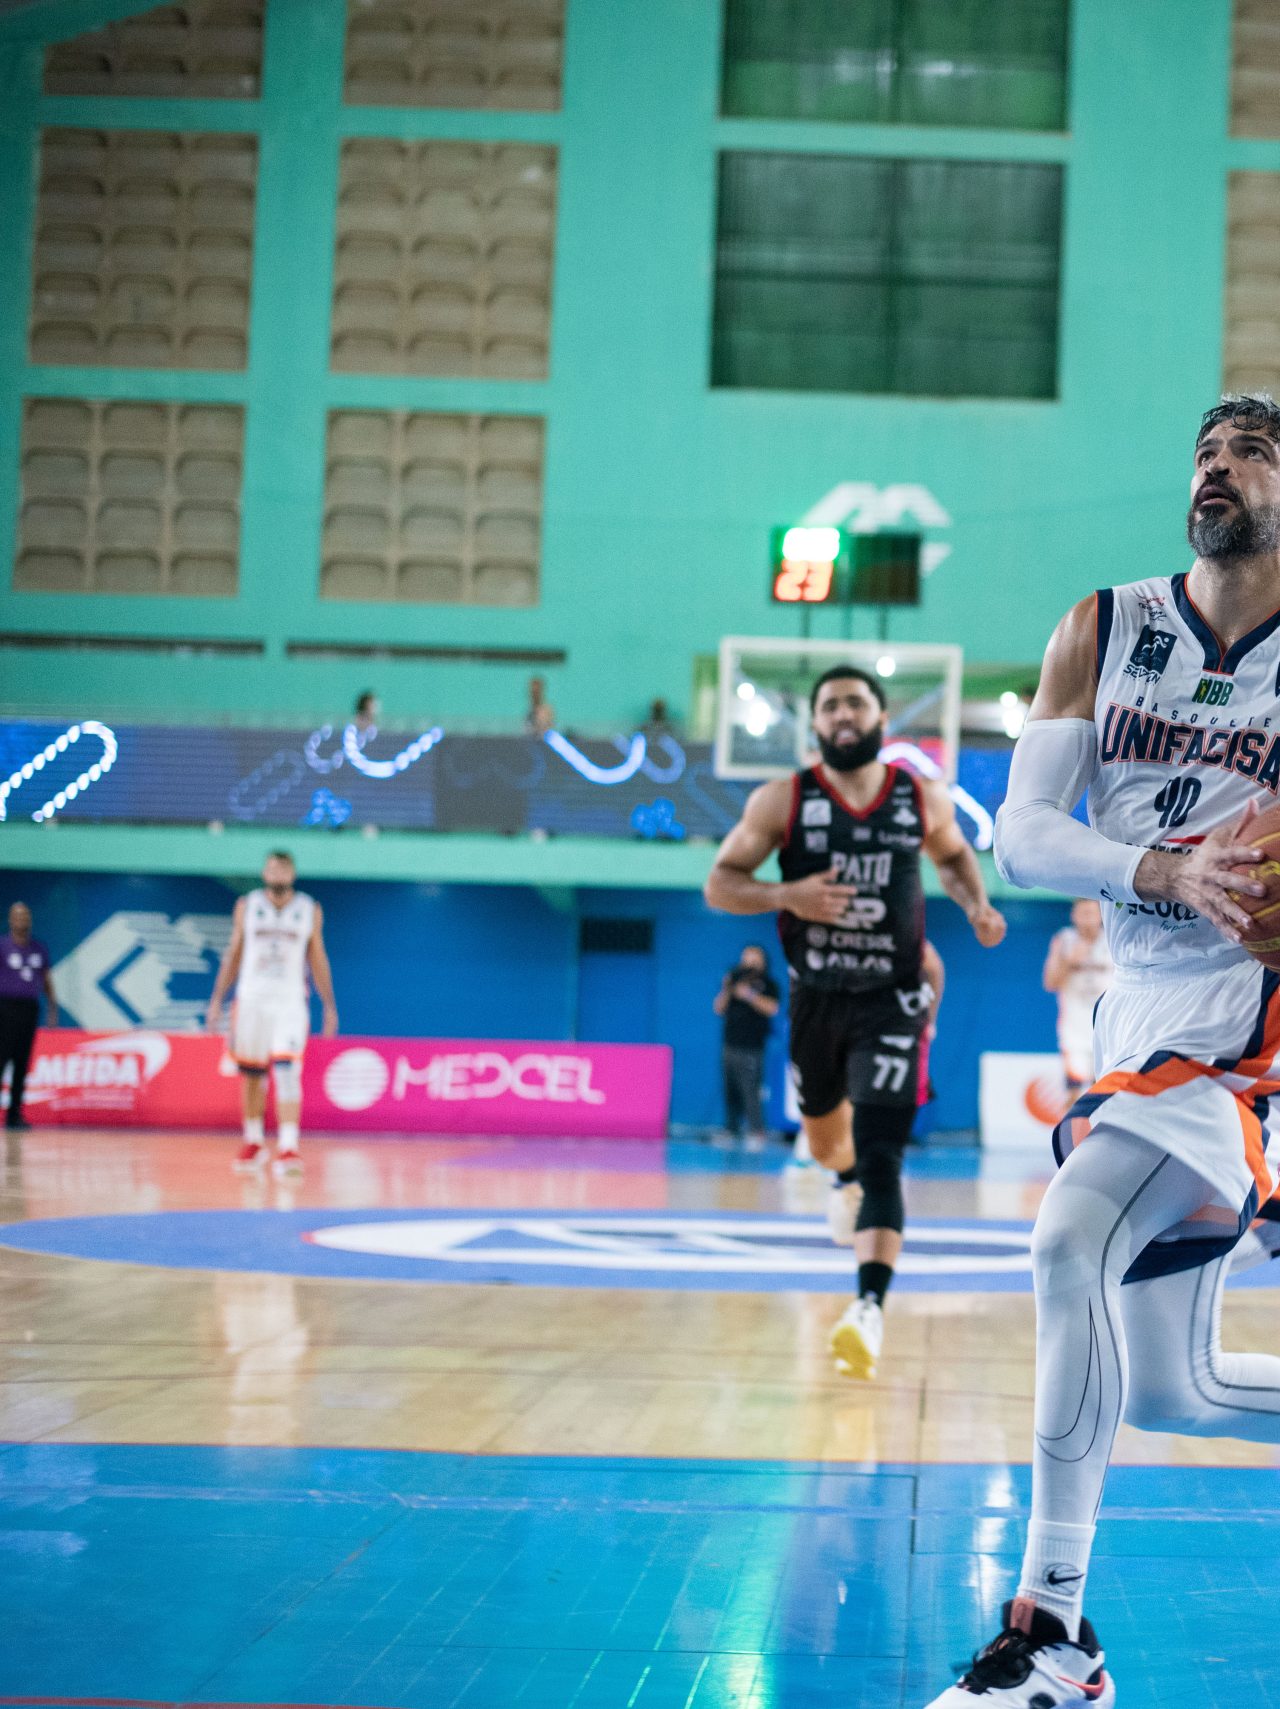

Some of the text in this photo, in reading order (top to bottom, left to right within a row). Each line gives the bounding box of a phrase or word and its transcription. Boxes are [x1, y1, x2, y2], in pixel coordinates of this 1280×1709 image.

[1191, 677, 1234, 707] NBB
[1135, 696, 1272, 728] BASQUETE
[1153, 776, 1202, 828] 40
[831, 851, 893, 887] PATO
[2, 1054, 141, 1088] MEIDA
[872, 1054, 909, 1092] 77
